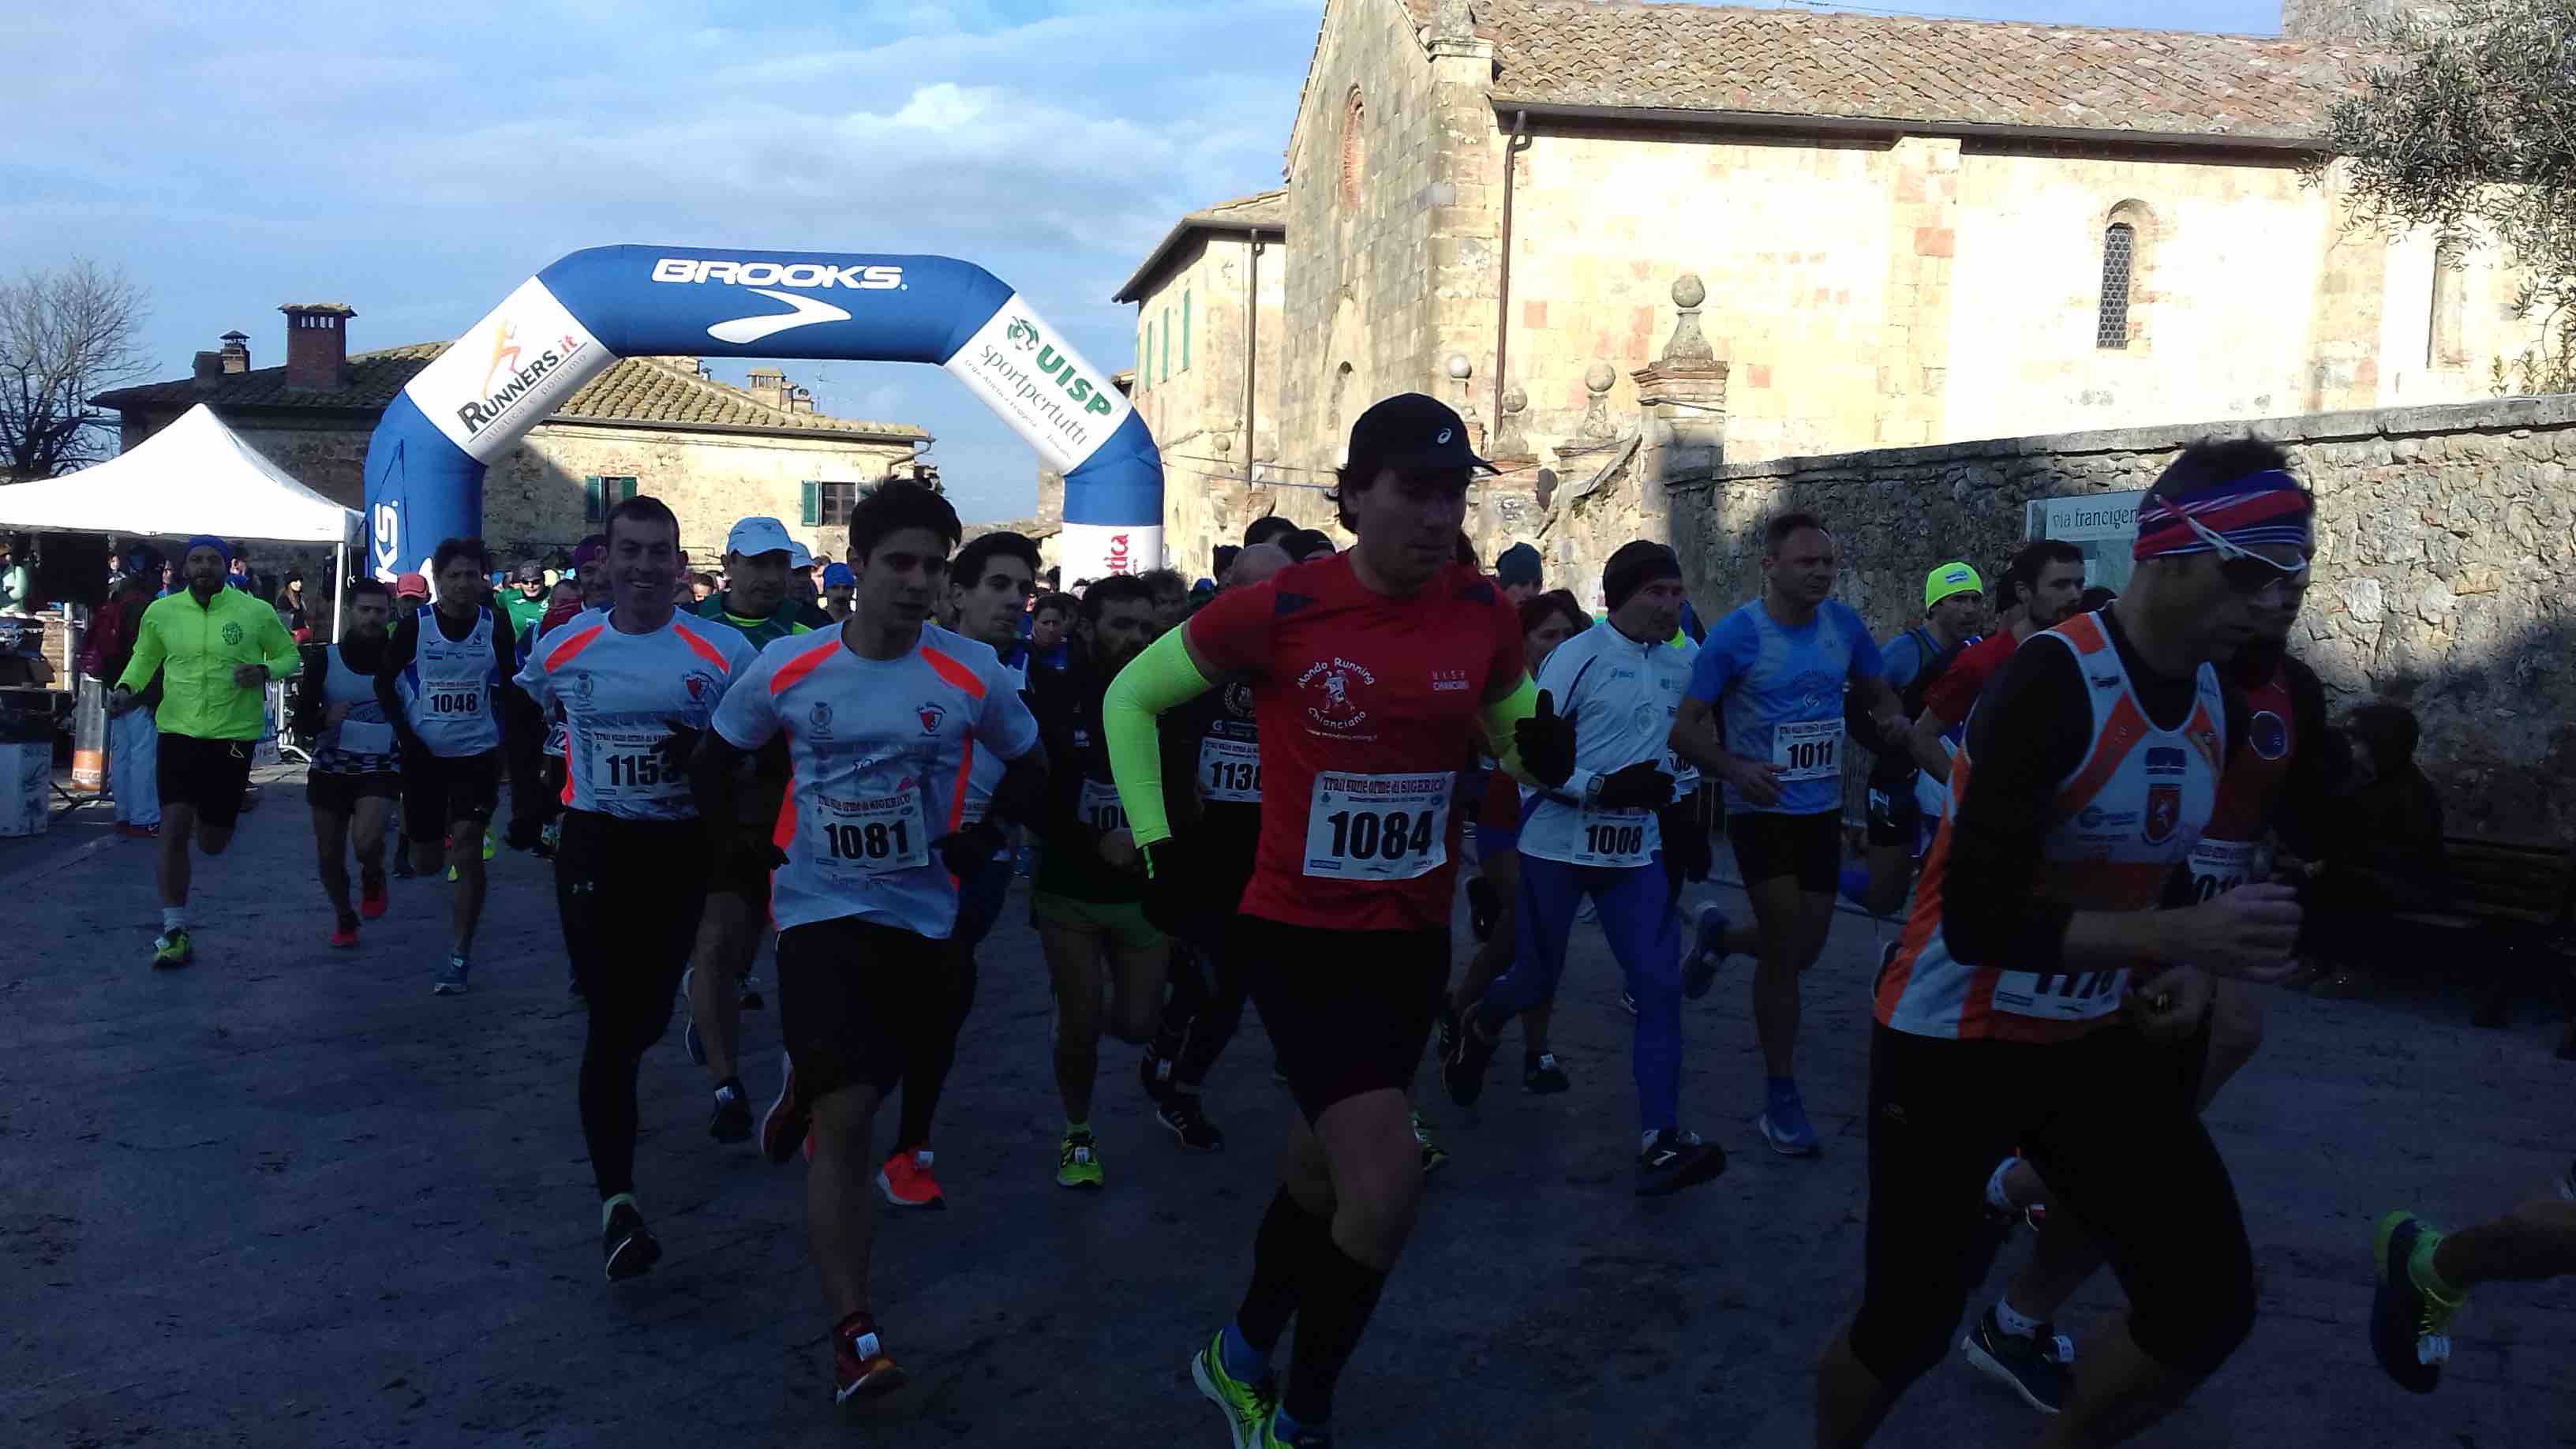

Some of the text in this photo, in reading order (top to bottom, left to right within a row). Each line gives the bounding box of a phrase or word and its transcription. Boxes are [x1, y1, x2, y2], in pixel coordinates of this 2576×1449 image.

[979, 344, 1088, 445] sportpertutti
[1036, 344, 1111, 416] UISP
[1295, 657, 1376, 689] Mondo Running
[431, 694, 477, 713] 1048
[1308, 707, 1367, 729] Chianciano
[1787, 739, 1834, 769] 1011
[824, 820, 908, 859] 1081
[1327, 811, 1434, 860] 1084
[1586, 825, 1643, 855] 1008
